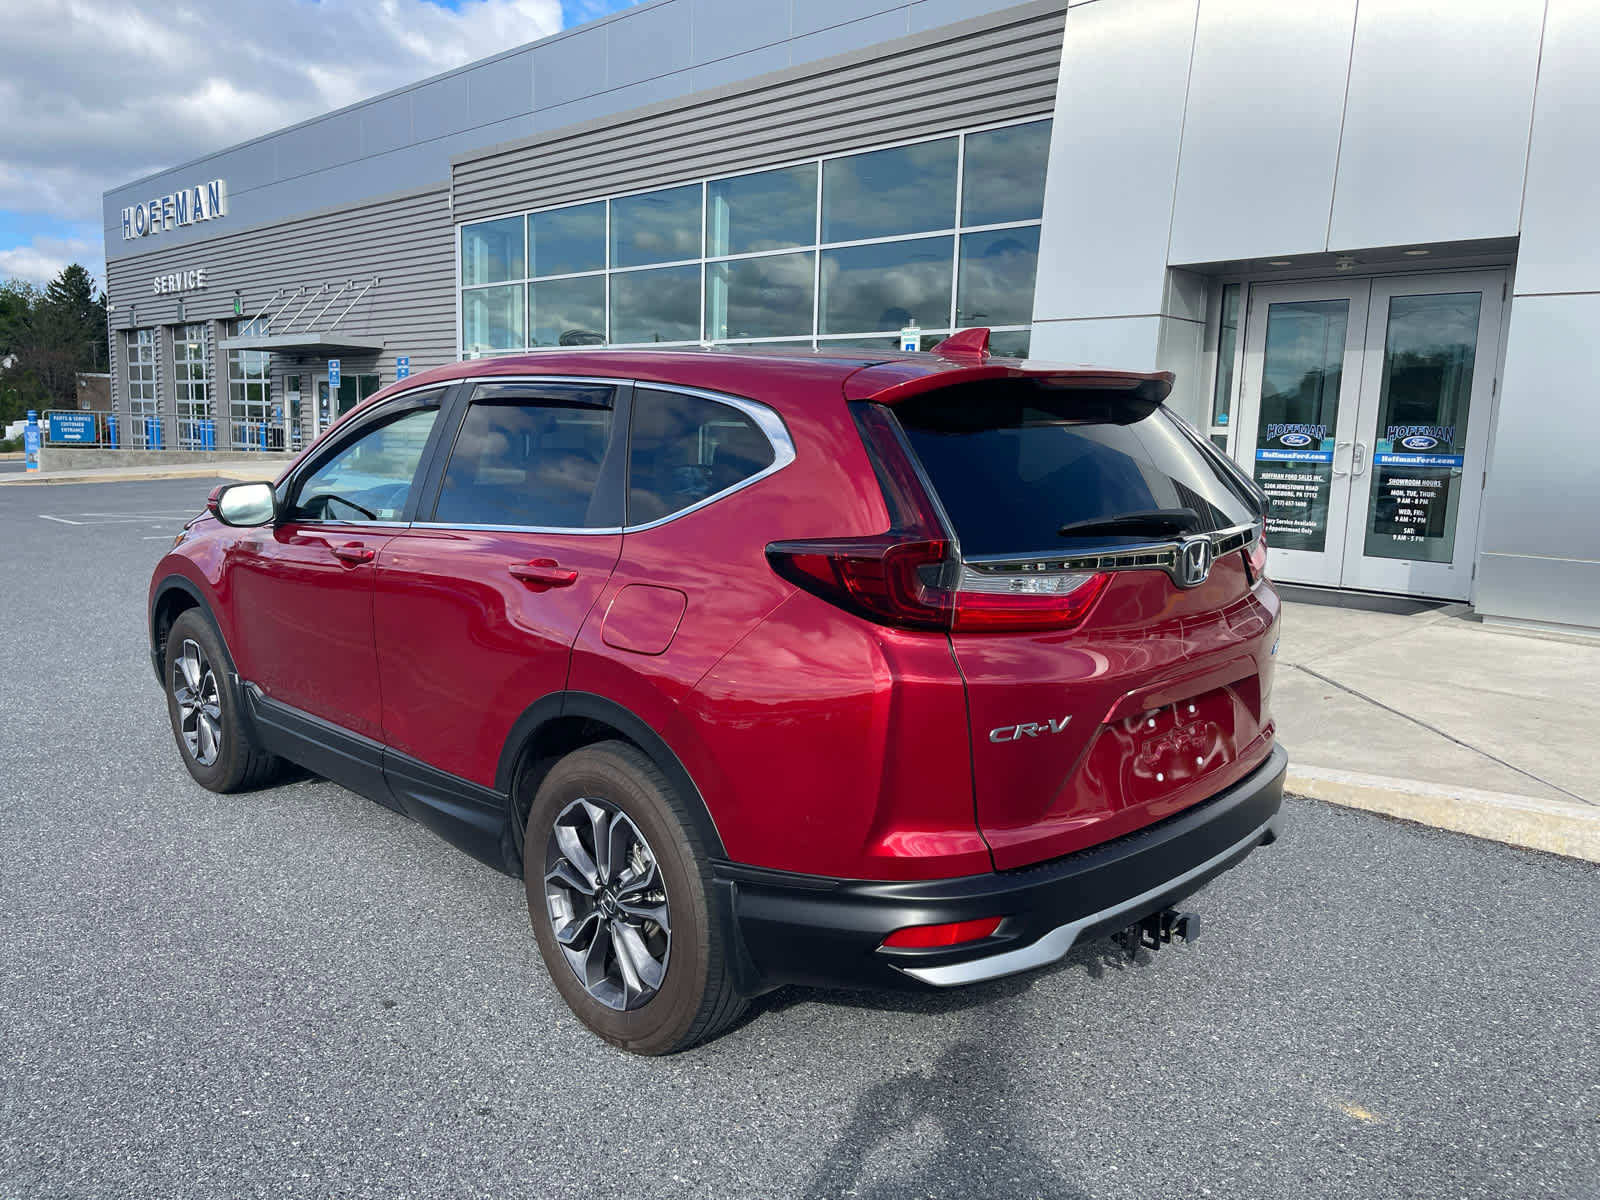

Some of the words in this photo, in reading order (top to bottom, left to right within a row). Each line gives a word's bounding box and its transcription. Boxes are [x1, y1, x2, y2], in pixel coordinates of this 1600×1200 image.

[121, 179, 225, 240] HOFFMAN
[153, 268, 207, 294] SERVICE
[1266, 424, 1327, 441] HOFFMAN
[1386, 425, 1456, 447] HOFFMAN
[1286, 435, 1305, 444] Ford
[1409, 438, 1430, 447] Ford
[1262, 451, 1327, 460] HoffmanFord.com
[1381, 455, 1455, 465] HoffmanFord.com
[1388, 478, 1421, 486] SHOWROOM
[989, 714, 1073, 743] CR-V
